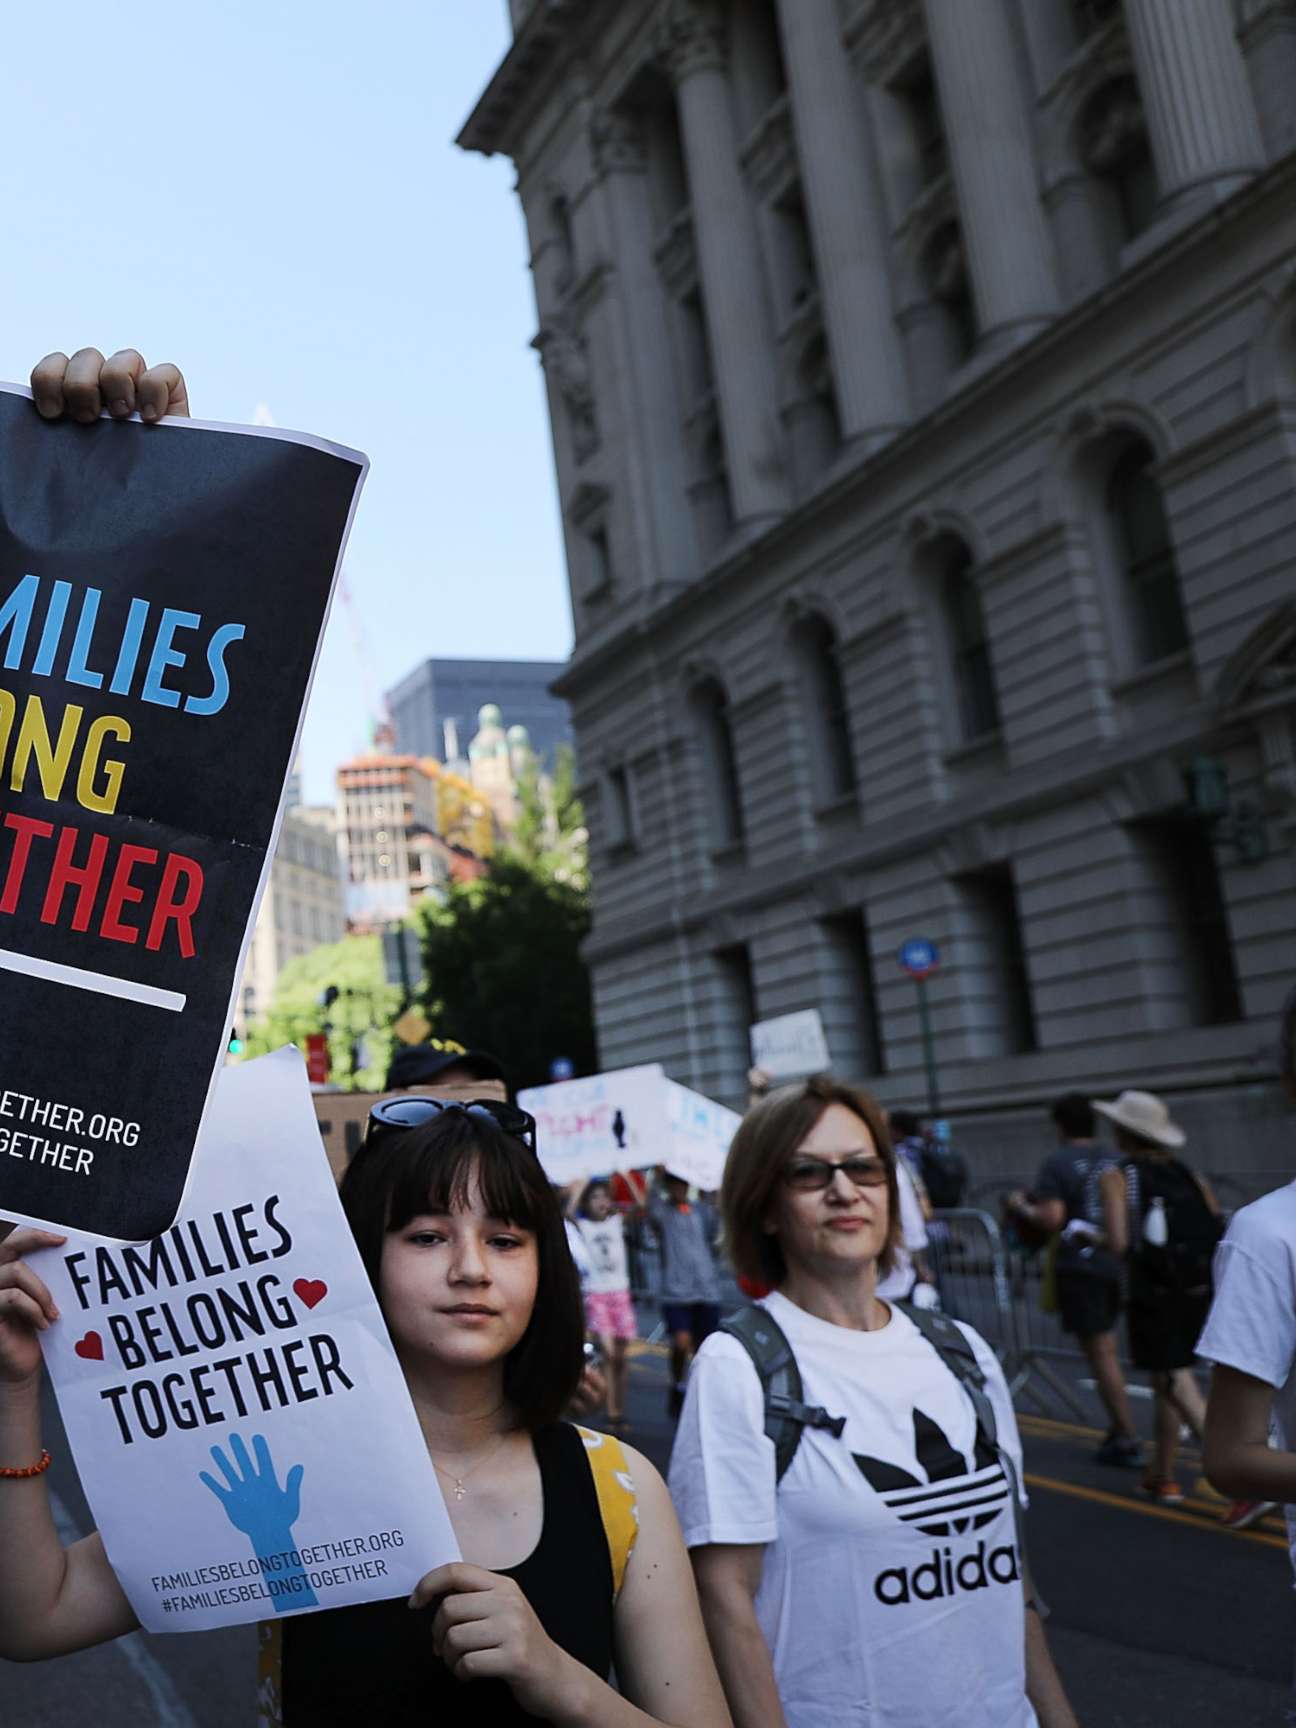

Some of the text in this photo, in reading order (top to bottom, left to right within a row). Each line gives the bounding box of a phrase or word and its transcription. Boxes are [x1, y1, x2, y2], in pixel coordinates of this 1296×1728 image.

[64, 1194, 292, 1310] FAMILIES
[108, 1274, 298, 1370] BELONG
[100, 1333, 354, 1445] TOGETHER
[151, 1529, 405, 1593] FAMILIESBELONGTOGETHER.ORG
[162, 1559, 389, 1613] #FAMILIESBELONGTOGETHER
[873, 1540, 1020, 1606] adida
